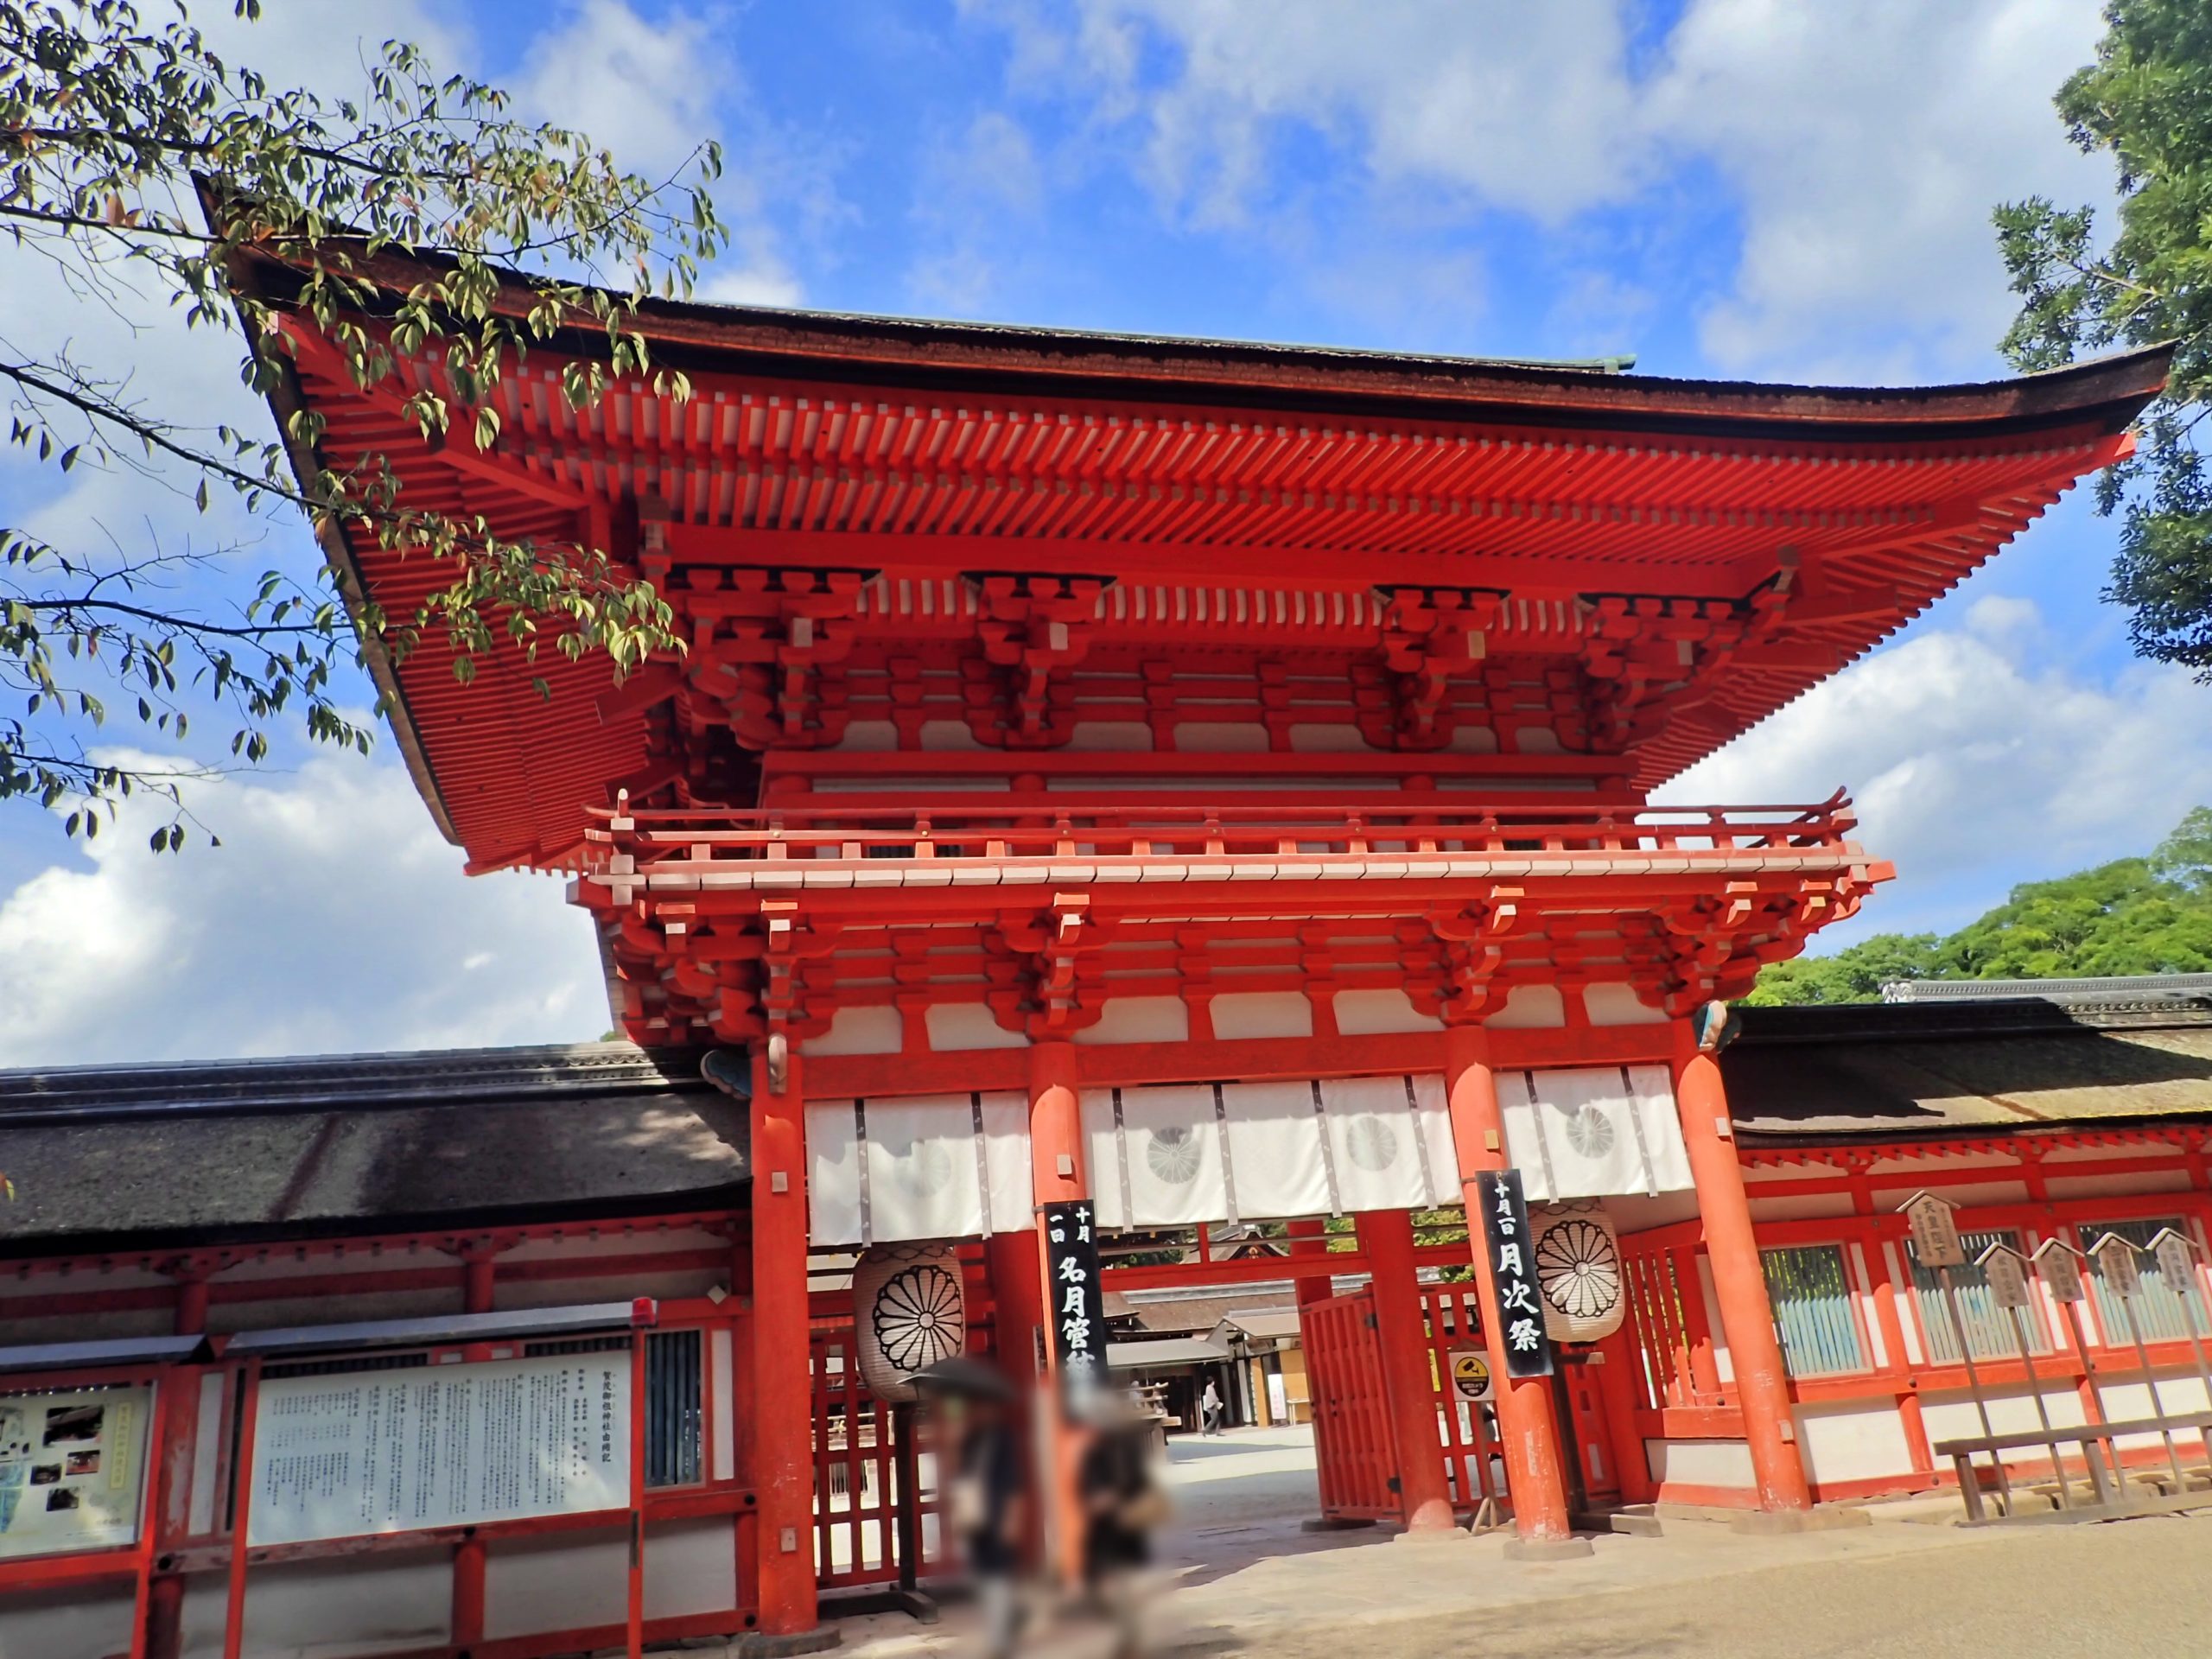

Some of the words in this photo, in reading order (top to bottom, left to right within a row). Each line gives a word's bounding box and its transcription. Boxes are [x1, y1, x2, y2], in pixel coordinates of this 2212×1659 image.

[1049, 1214, 1065, 1243] 一日
[1076, 1206, 1091, 1243] 十月
[1058, 1256, 1099, 1410] 名月管絃
[1497, 1243, 1541, 1351] 月次祭
